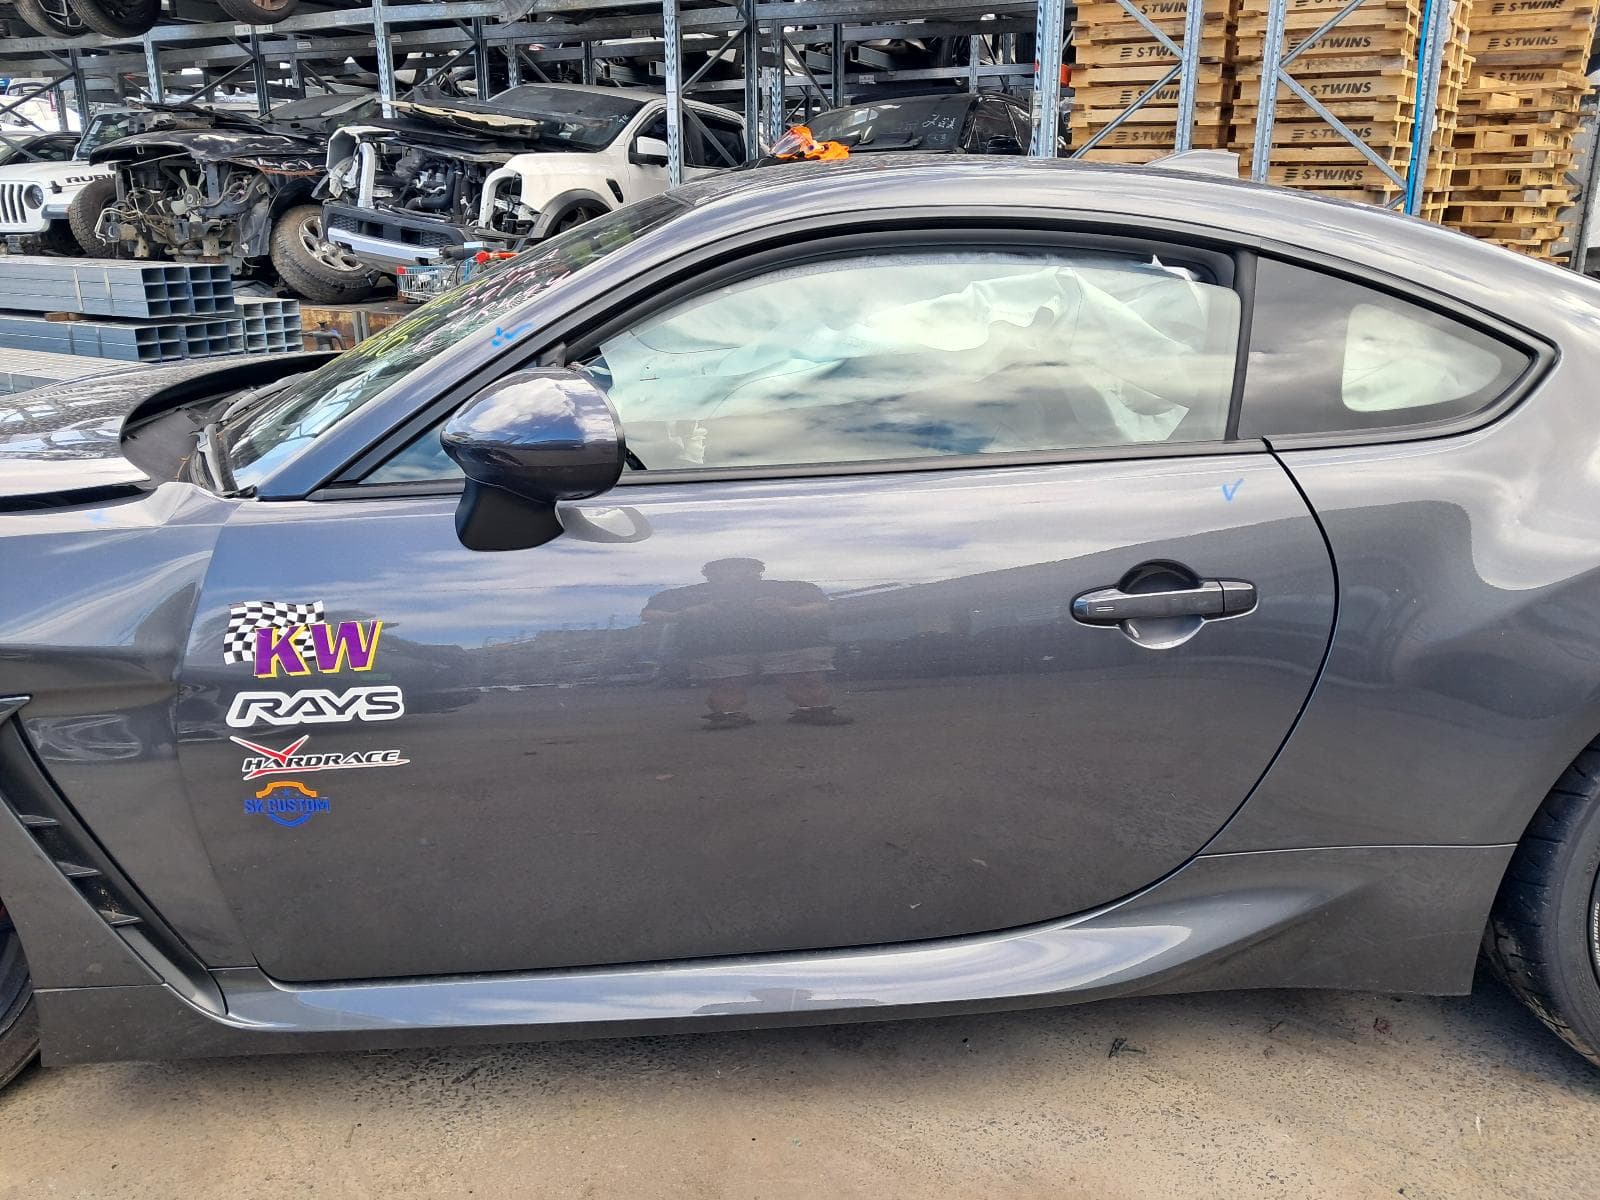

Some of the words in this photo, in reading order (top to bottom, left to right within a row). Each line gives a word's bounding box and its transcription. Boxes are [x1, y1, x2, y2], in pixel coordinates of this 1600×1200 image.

[254, 620, 383, 678] KW
[227, 687, 404, 727] RAYS
[242, 750, 401, 772] HARDRACE
[268, 798, 330, 813] CUSTOM
